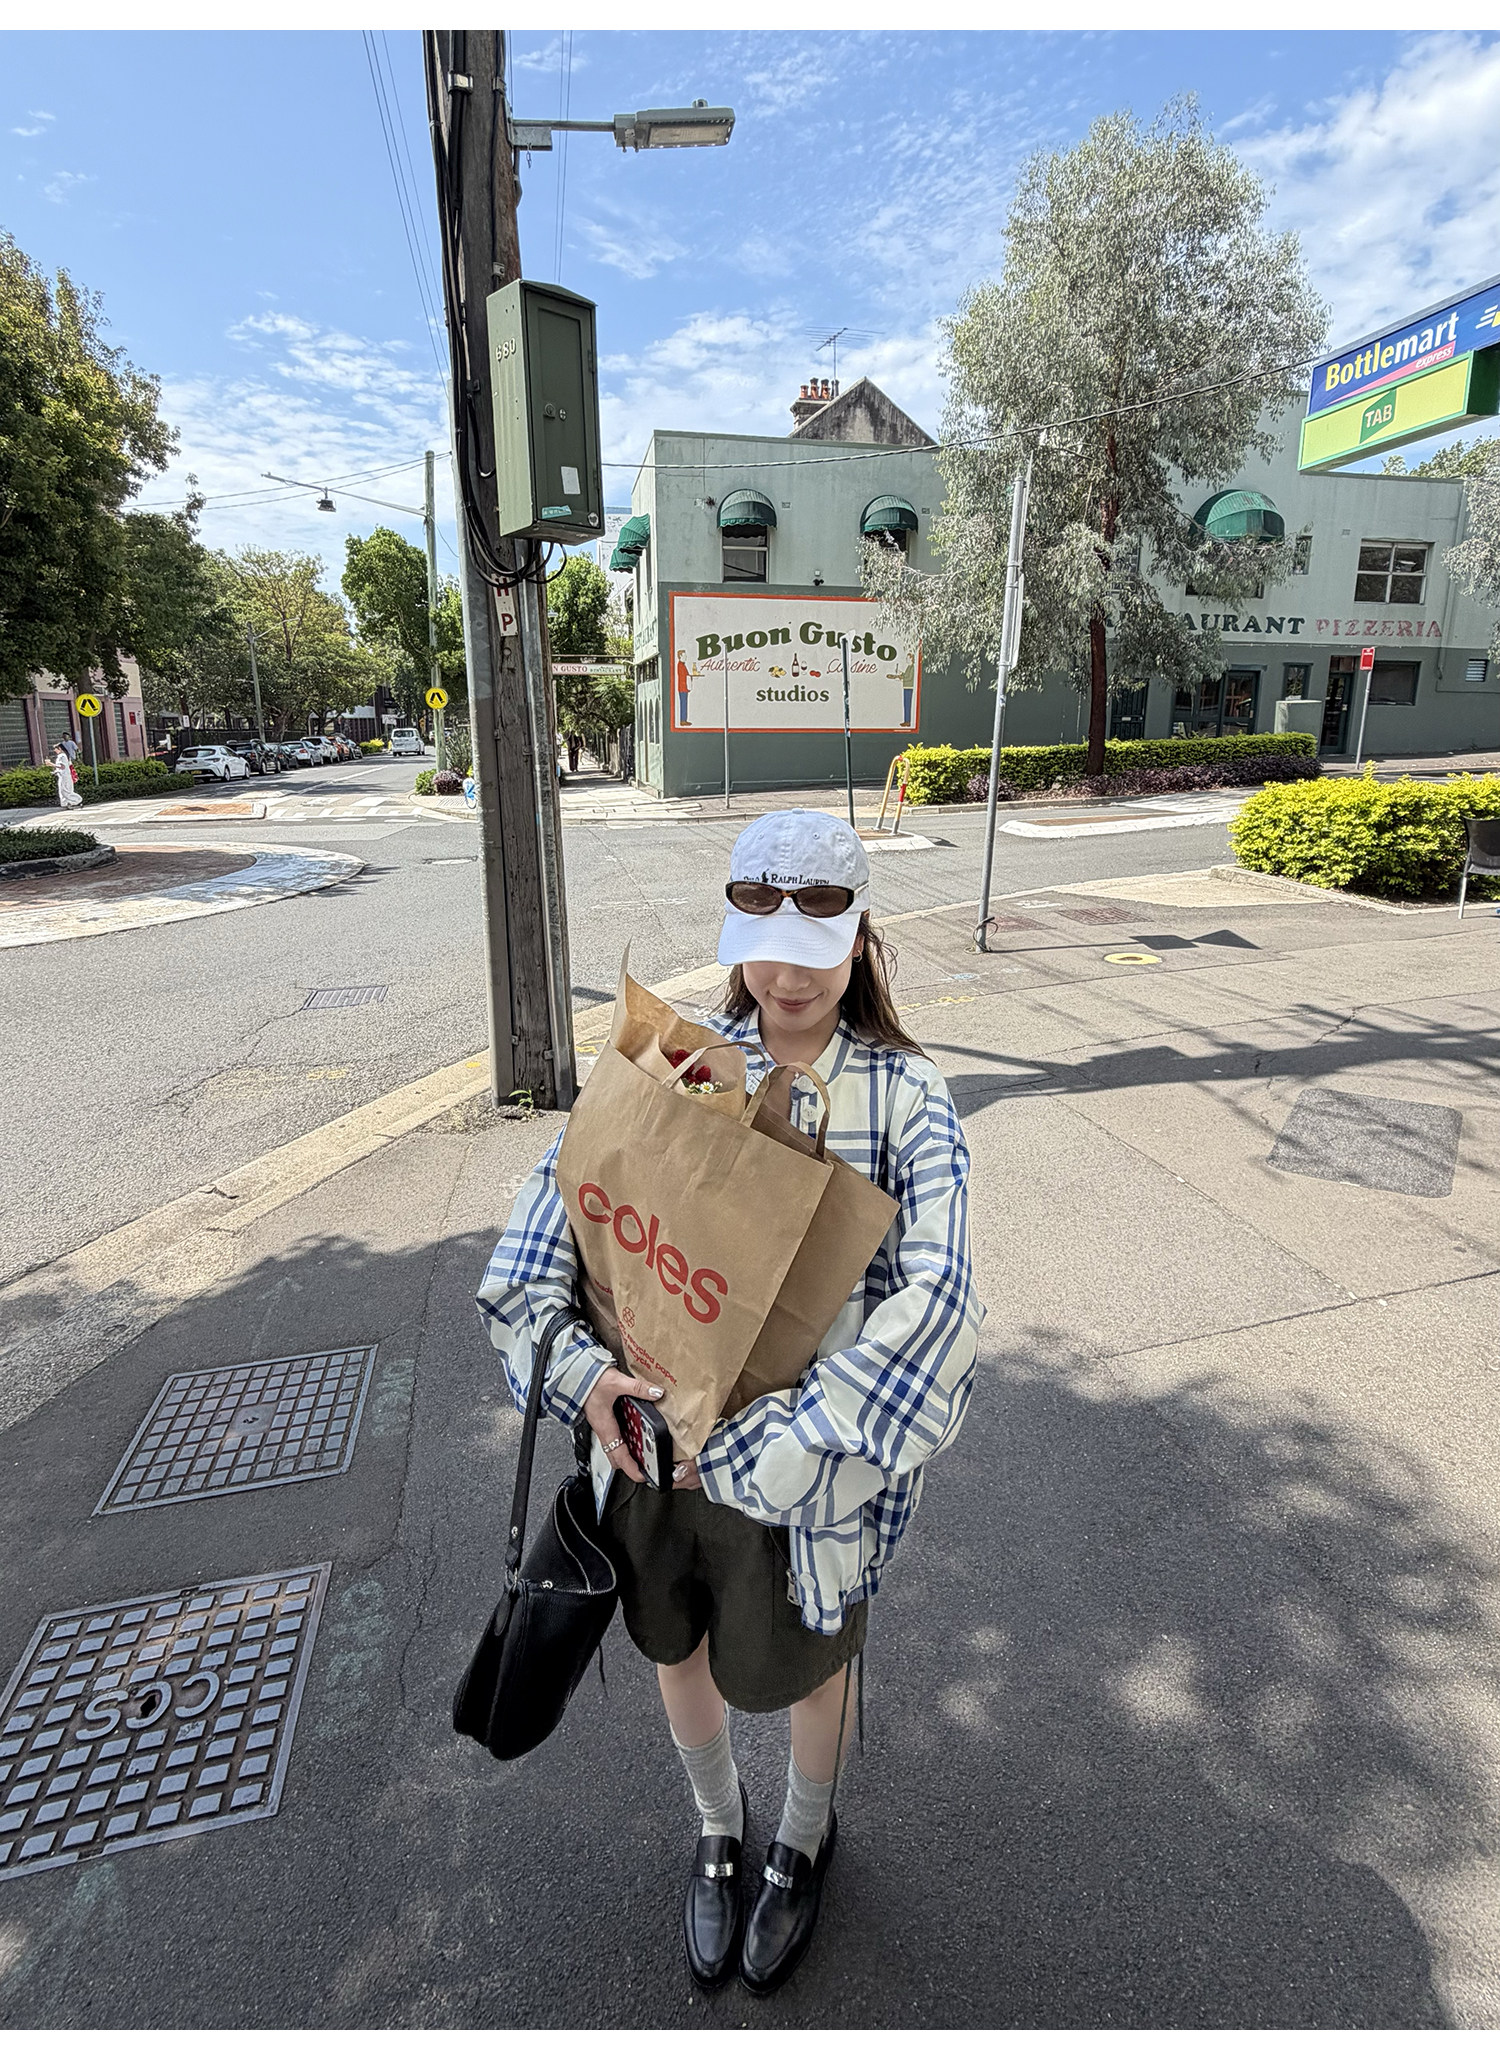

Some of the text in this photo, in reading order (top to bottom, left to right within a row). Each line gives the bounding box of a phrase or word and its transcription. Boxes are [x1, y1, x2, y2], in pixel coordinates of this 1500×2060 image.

[495, 337, 517, 361] 680
[1324, 311, 1459, 392] Bottlemart
[1415, 345, 1453, 369] express
[1365, 404, 1393, 428] TAB
[1316, 618, 1443, 638] PIZZERIA
[696, 626, 792, 661] Buon
[799, 621, 897, 662] Gusto
[561, 665, 588, 673] GUSTO
[756, 685, 829, 702] studios
[578, 1182, 728, 1324] coles
[627, 1333, 678, 1387] recycled paper.
